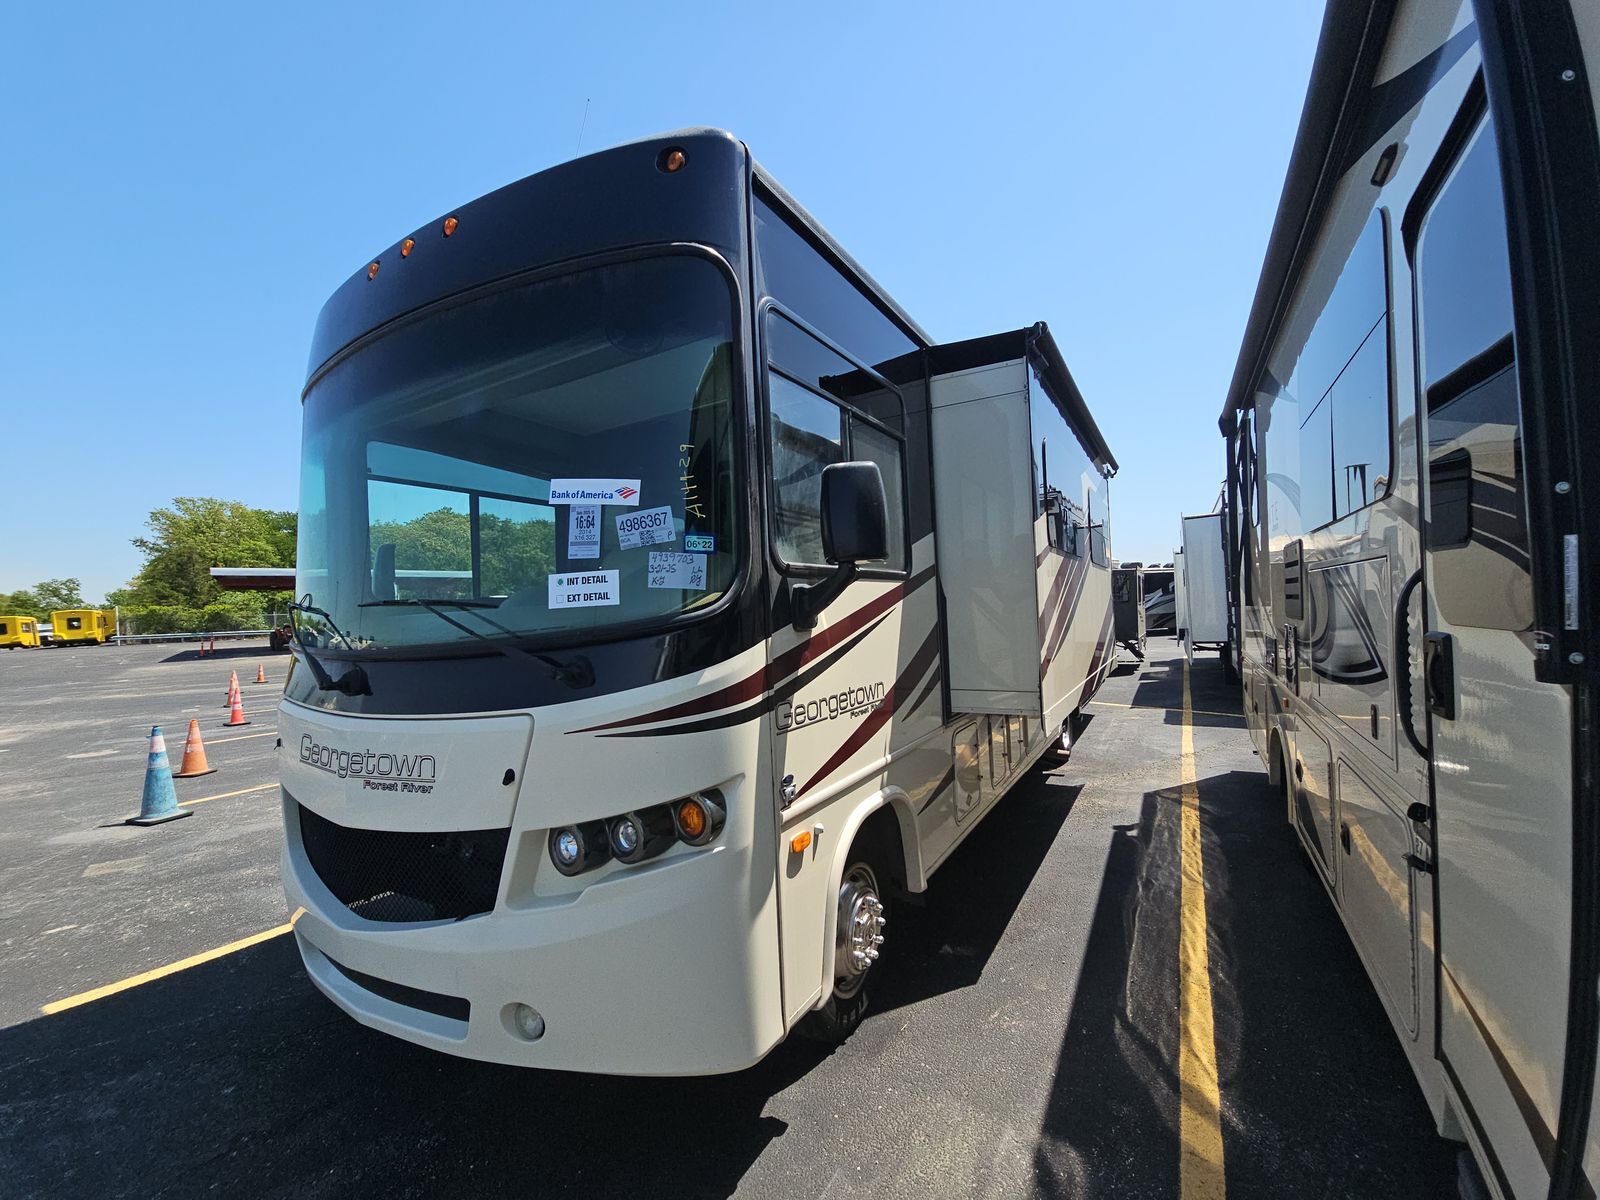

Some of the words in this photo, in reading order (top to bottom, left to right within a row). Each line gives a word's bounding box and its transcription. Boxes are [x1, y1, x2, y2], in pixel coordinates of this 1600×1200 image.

[551, 490, 571, 499] Bank
[571, 490, 580, 499] of
[580, 490, 614, 500] America
[576, 515, 595, 529] 16:64
[619, 512, 668, 533] 4986367
[566, 577, 580, 586] INT
[581, 575, 609, 585] DETAIL
[567, 593, 582, 603] EXT
[583, 592, 611, 602] DETAIL
[774, 681, 885, 732] Georgetown
[300, 733, 436, 779] Georgetown
[363, 779, 399, 792] Forest
[400, 782, 434, 794] River
